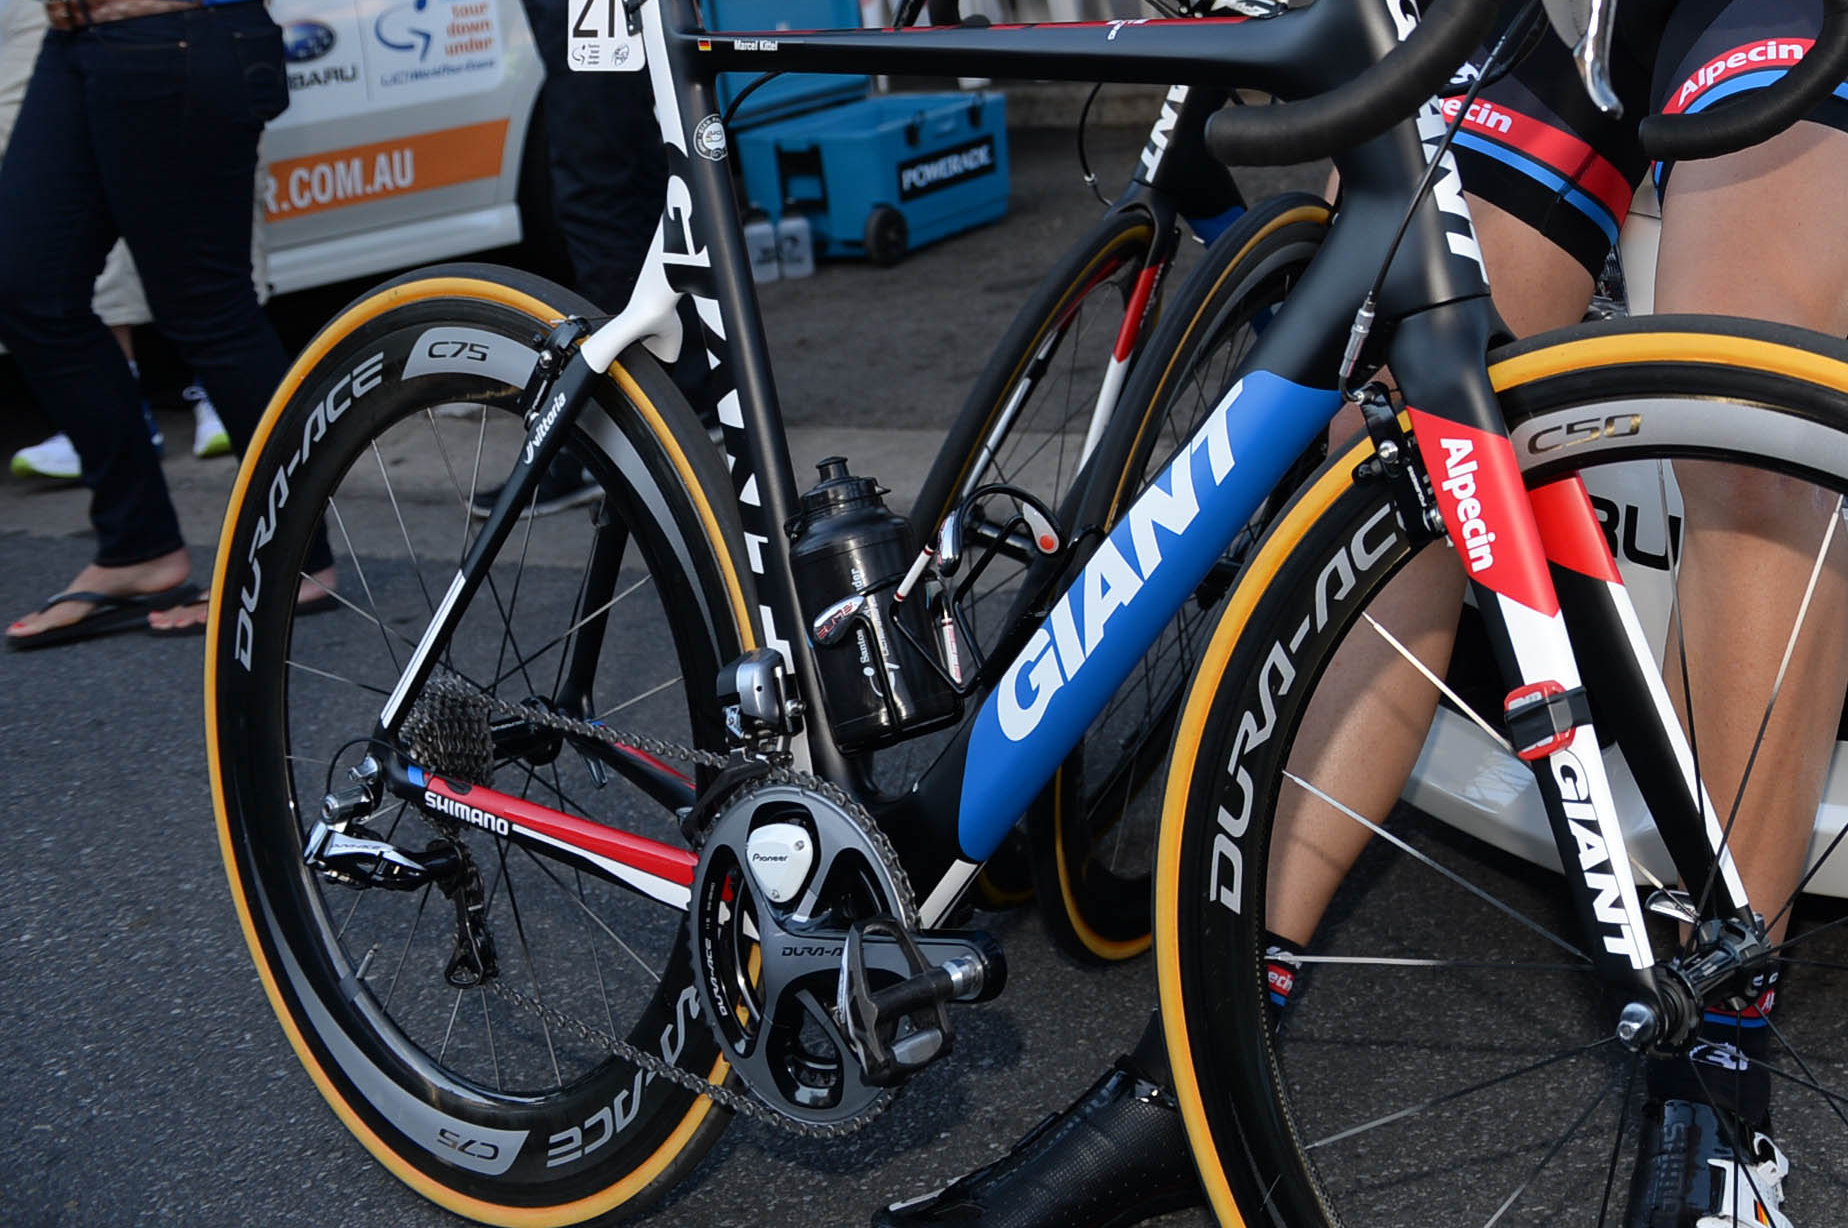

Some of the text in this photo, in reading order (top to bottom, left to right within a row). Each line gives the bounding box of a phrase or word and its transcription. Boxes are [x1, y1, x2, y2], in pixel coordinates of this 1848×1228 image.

[445, 37, 492, 56] under
[447, 18, 490, 37] down
[734, 40, 758, 51] Marcel
[1678, 41, 1804, 107] Alpecin
[1438, 97, 1513, 134] ecin
[264, 148, 414, 214] R.COM.AU
[902, 145, 992, 191] POWERADE
[428, 341, 490, 362] C75
[532, 392, 566, 447] vittoria
[1528, 412, 1642, 456] C50
[235, 351, 384, 672] DURA-ACE
[1439, 437, 1494, 574] Alpecin
[997, 378, 1244, 742] GIANT
[856, 629, 870, 664] Santos
[1209, 503, 1406, 915] DURA-AC
[424, 790, 509, 836] SHIMANO
[752, 852, 788, 863] Pioneer
[1550, 750, 1655, 970] GIANT
[781, 946, 845, 957] DURA-A
[437, 1128, 500, 1161] C75
